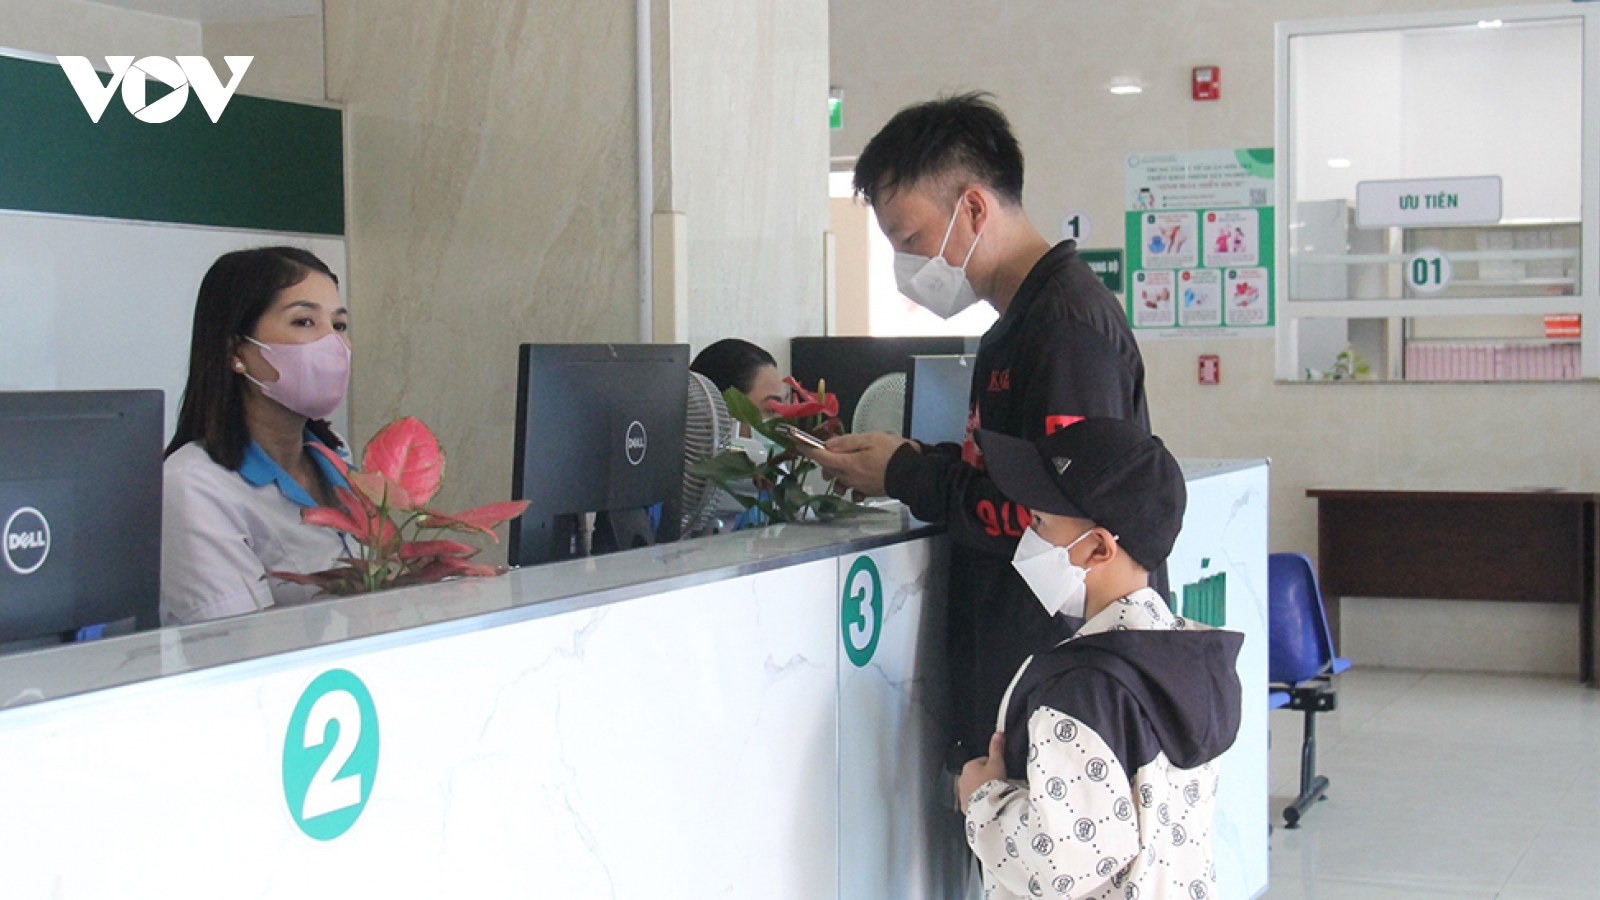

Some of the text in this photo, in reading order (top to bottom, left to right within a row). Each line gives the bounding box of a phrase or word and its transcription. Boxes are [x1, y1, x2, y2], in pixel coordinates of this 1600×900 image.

[1399, 191, 1458, 210] ƯU TIÊN
[1068, 215, 1079, 237] 1
[1412, 257, 1441, 285] 01
[628, 437, 645, 448] DELL
[9, 531, 45, 550] DELL
[849, 569, 875, 650] 3
[302, 689, 362, 821] 2
